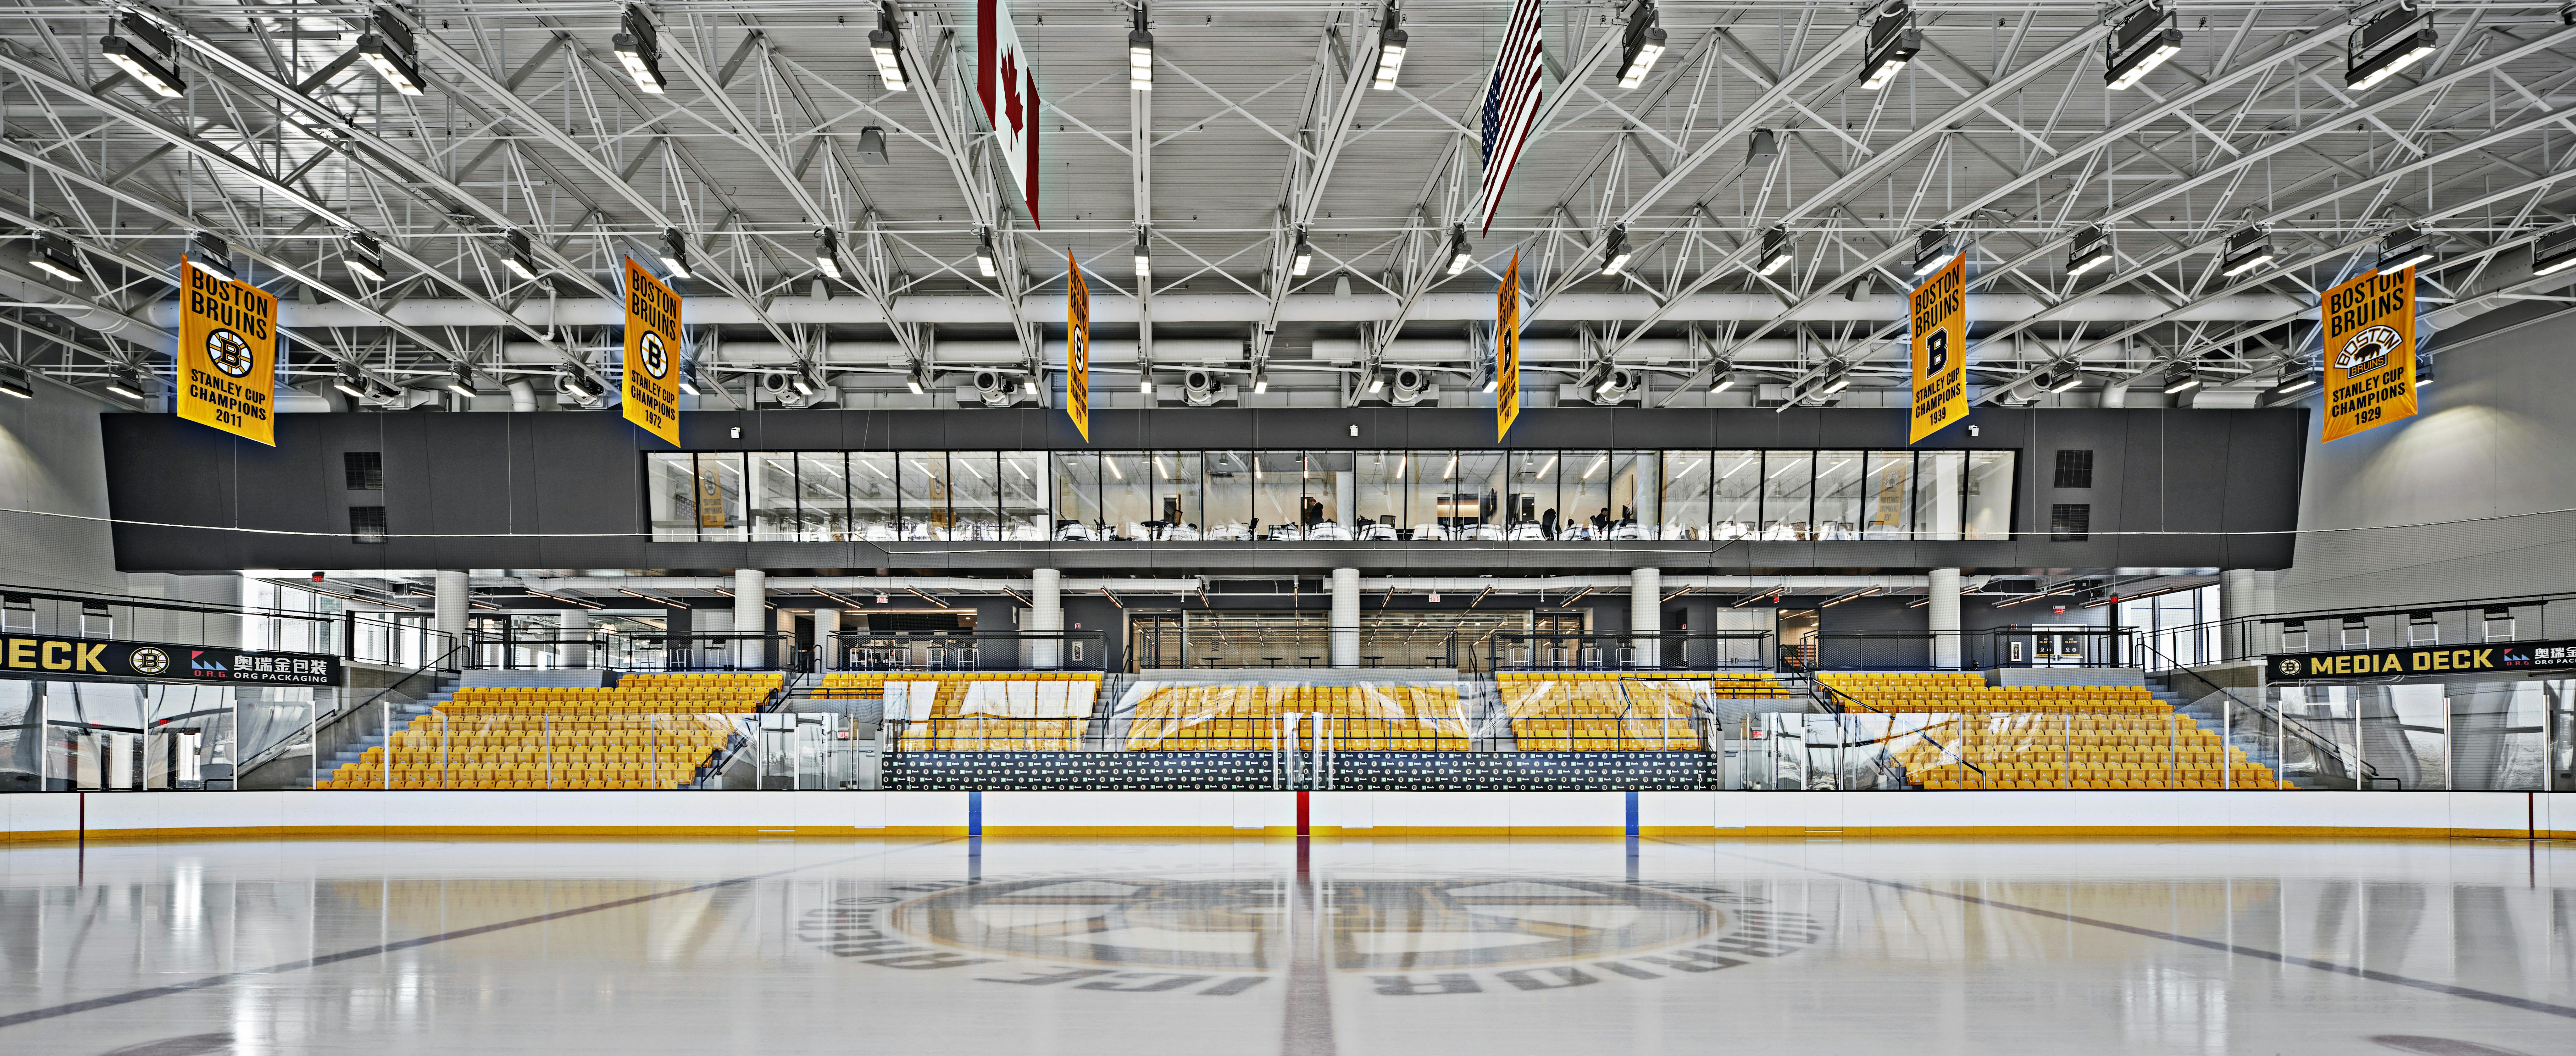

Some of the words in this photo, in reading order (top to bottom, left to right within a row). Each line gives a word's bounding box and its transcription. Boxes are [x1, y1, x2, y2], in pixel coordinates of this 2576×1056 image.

[192, 267, 267, 318] BOSTON
[632, 268, 676, 319] BOSTON
[1071, 261, 1087, 310] BOSTON
[1500, 262, 1516, 311] BOSTON
[1915, 264, 1959, 316] BOSTON
[2331, 268, 2404, 315] BOSTON
[192, 290, 267, 340] BRUINS
[632, 292, 675, 341] BRUINS
[1071, 287, 1087, 335] BRUINS
[1500, 289, 1516, 337] BRUINS
[1915, 289, 1959, 339] BRUINS
[2331, 288, 2404, 338] BRUINS
[1503, 325, 1512, 378] B
[1927, 326, 1948, 380] B
[2336, 328, 2400, 367] BOSTON
[1071, 366, 1082, 393] STANLEY
[2351, 356, 2384, 376] BRUINS
[190, 384, 266, 421] CHAMPIONS
[192, 369, 242, 397] STANLEY
[246, 388, 265, 405] CUP
[631, 385, 675, 421] CHAMPIONS
[632, 370, 661, 396] STANLEY
[663, 389, 675, 404] CUP
[1071, 382, 1087, 417] CHAMPIONS
[1500, 375, 1510, 401] STANLEY
[1500, 382, 1516, 417] CHAMPIONS
[1916, 378, 1945, 403] STANLEY
[1947, 367, 1959, 386] CUP
[1916, 383, 1961, 418] CHAMPIONS
[2332, 382, 2406, 418] CHAMPIONS
[2333, 375, 2380, 403] STANLEY
[2383, 367, 2404, 385] CUP
[216, 409, 241, 428] 2011
[645, 410, 661, 429] 1972
[1930, 409, 1946, 426] 1939
[2354, 406, 2381, 425] 1929
[0, 638, 108, 672] ECK
[234, 655, 327, 675] 奥瑞金包装
[2311, 653, 2403, 675] MEDIA
[2413, 649, 2493, 670] DECK
[262, 674, 327, 683] PACKAGING
